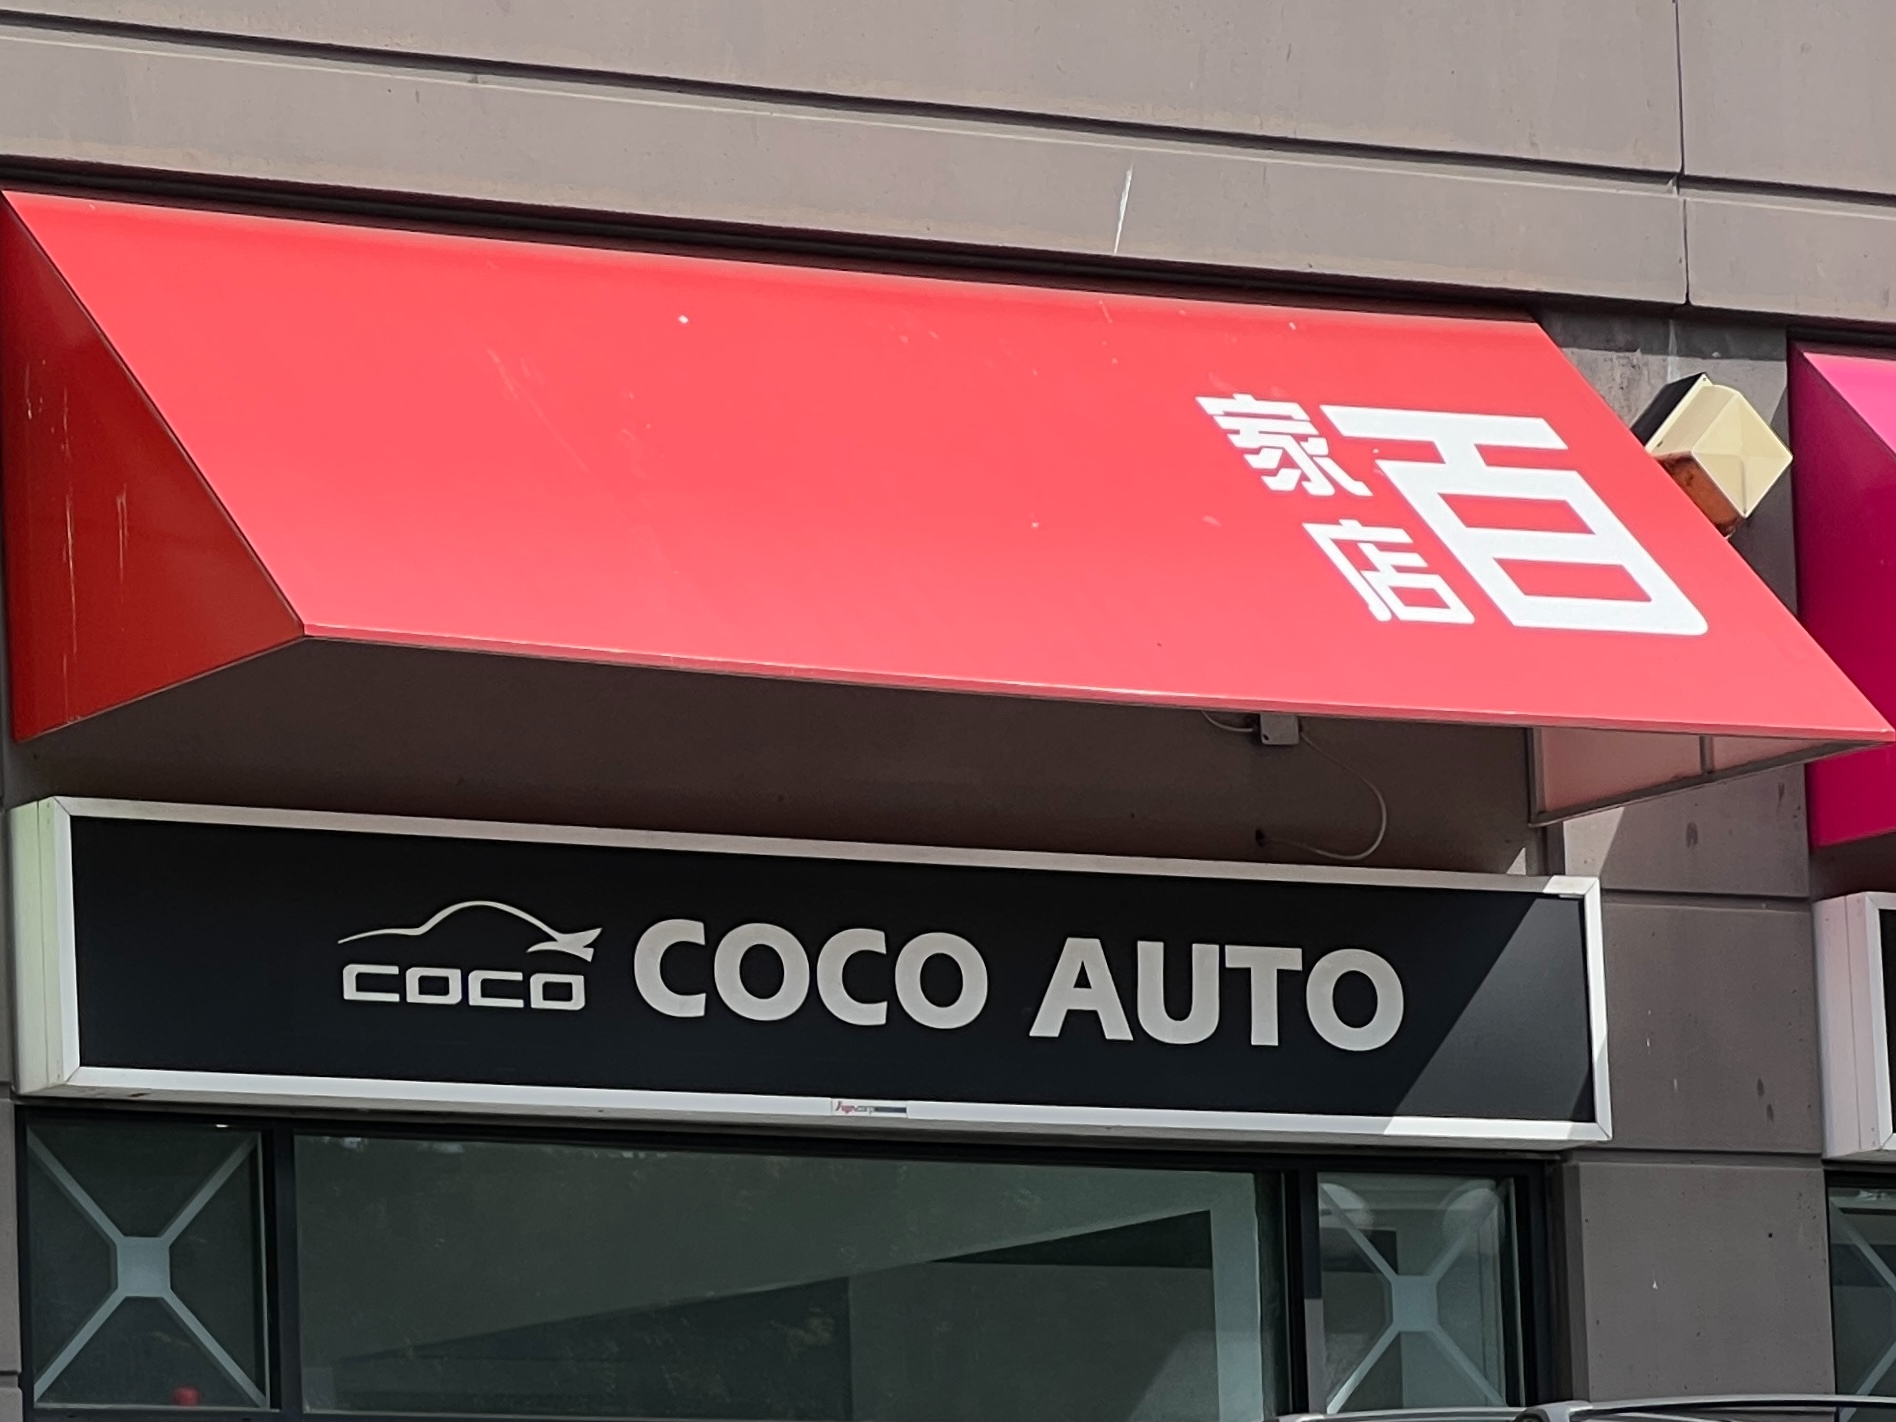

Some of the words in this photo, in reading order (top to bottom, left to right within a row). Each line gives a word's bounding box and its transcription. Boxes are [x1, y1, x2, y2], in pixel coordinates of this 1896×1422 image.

[342, 963, 586, 1011] COCO
[633, 918, 988, 1030] COCO
[1028, 937, 1404, 1052] AUTO
